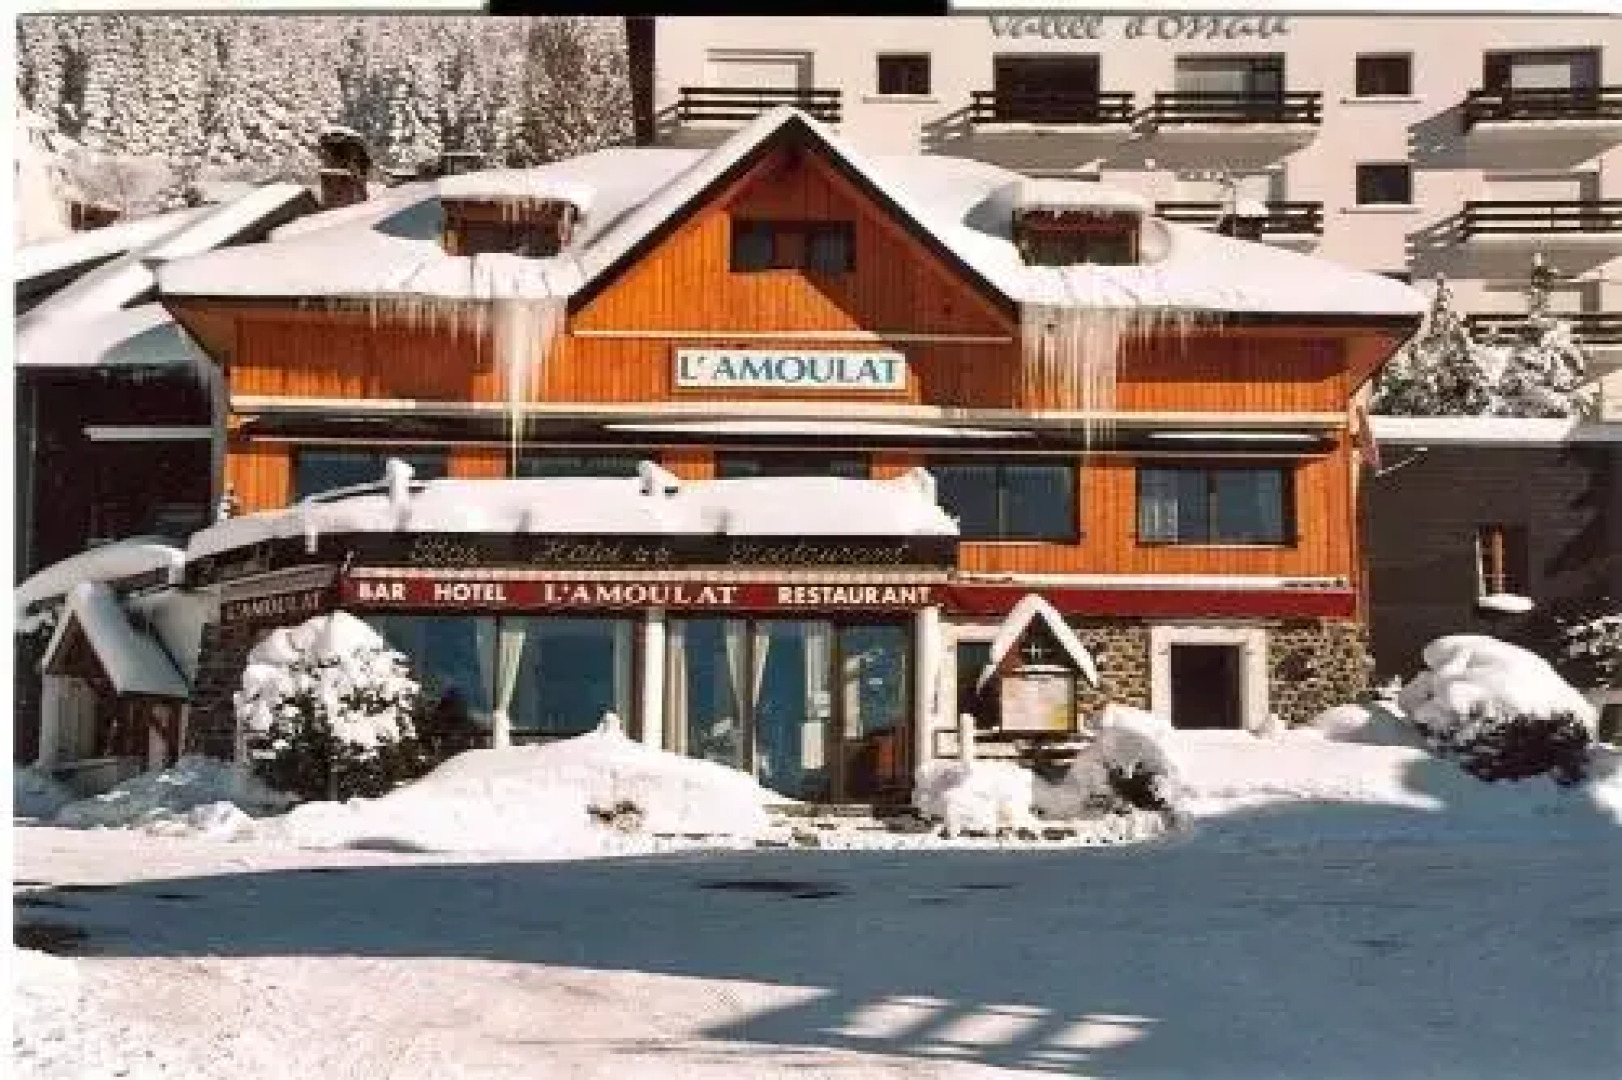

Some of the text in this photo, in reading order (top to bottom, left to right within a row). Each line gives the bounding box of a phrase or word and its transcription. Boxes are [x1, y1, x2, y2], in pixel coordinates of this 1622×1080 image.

[679, 356, 904, 383] L'AMOULAT
[358, 583, 933, 605] BAR HOTEL L'AMOULAT RESTAURANT
